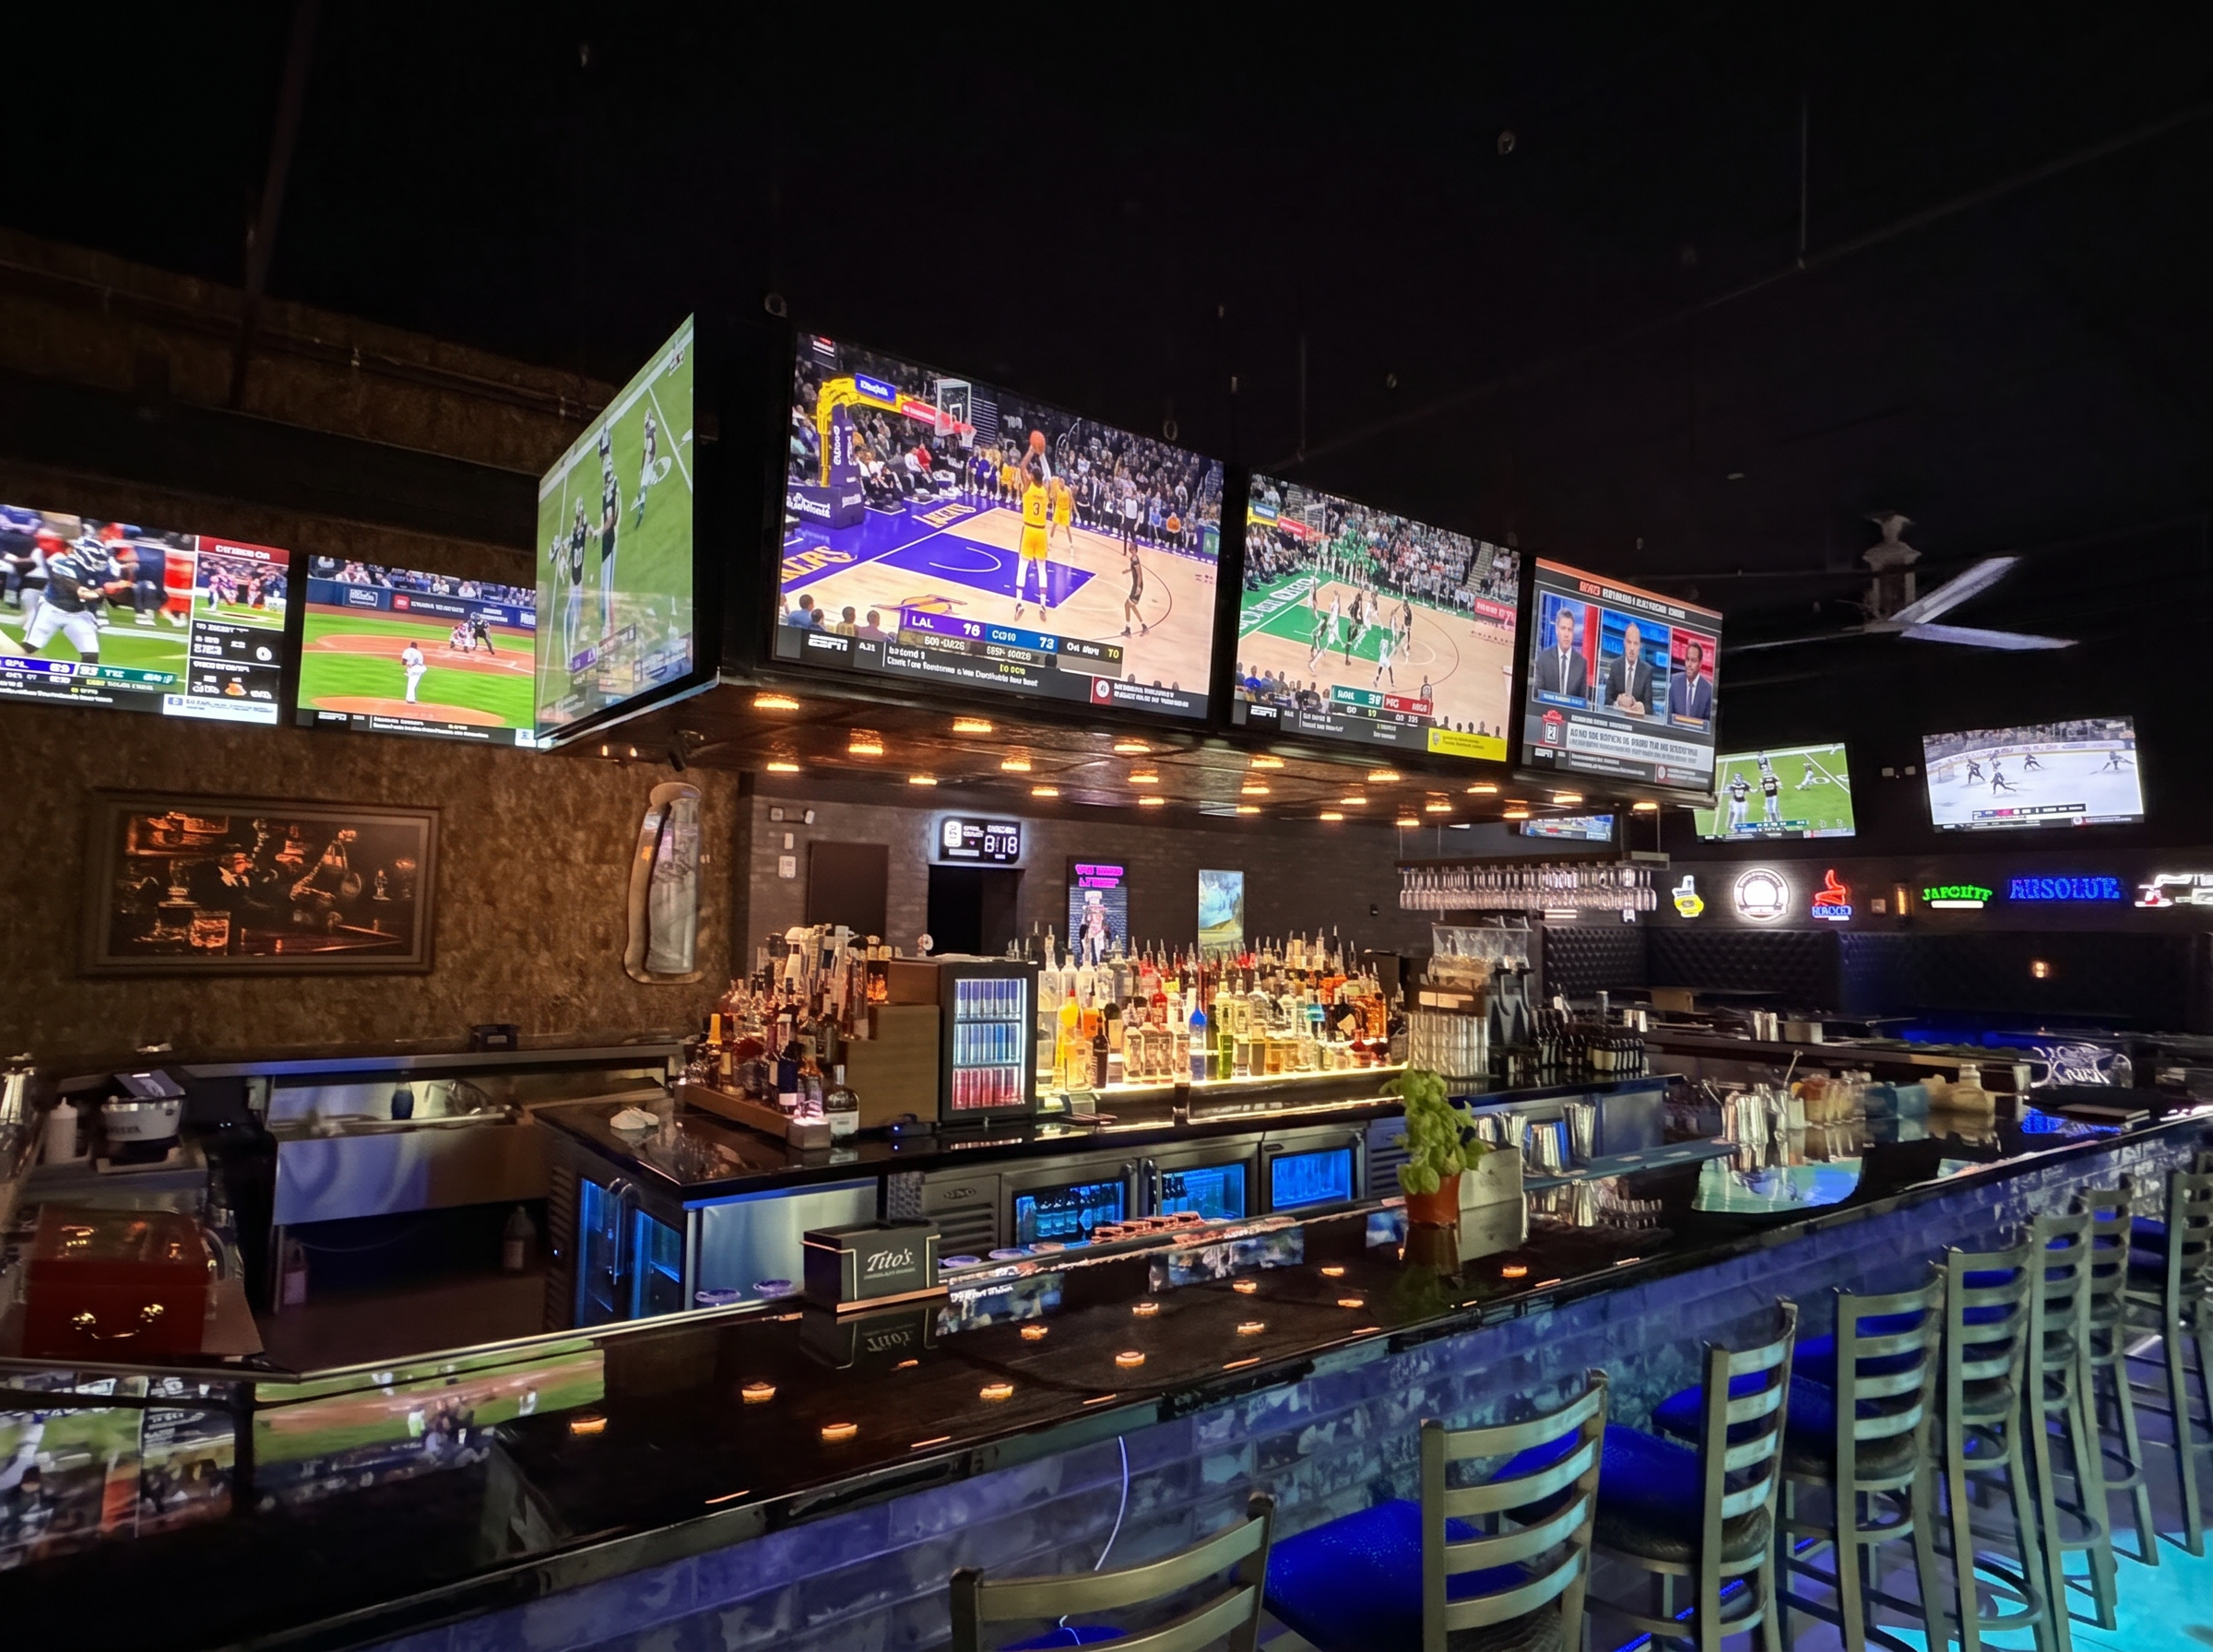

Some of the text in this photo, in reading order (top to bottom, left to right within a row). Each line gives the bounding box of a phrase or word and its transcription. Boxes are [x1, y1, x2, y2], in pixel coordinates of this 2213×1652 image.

[911, 615, 935, 629] LAL
[808, 633, 848, 652] ESPN
[867, 1247, 913, 1272] Tito's
